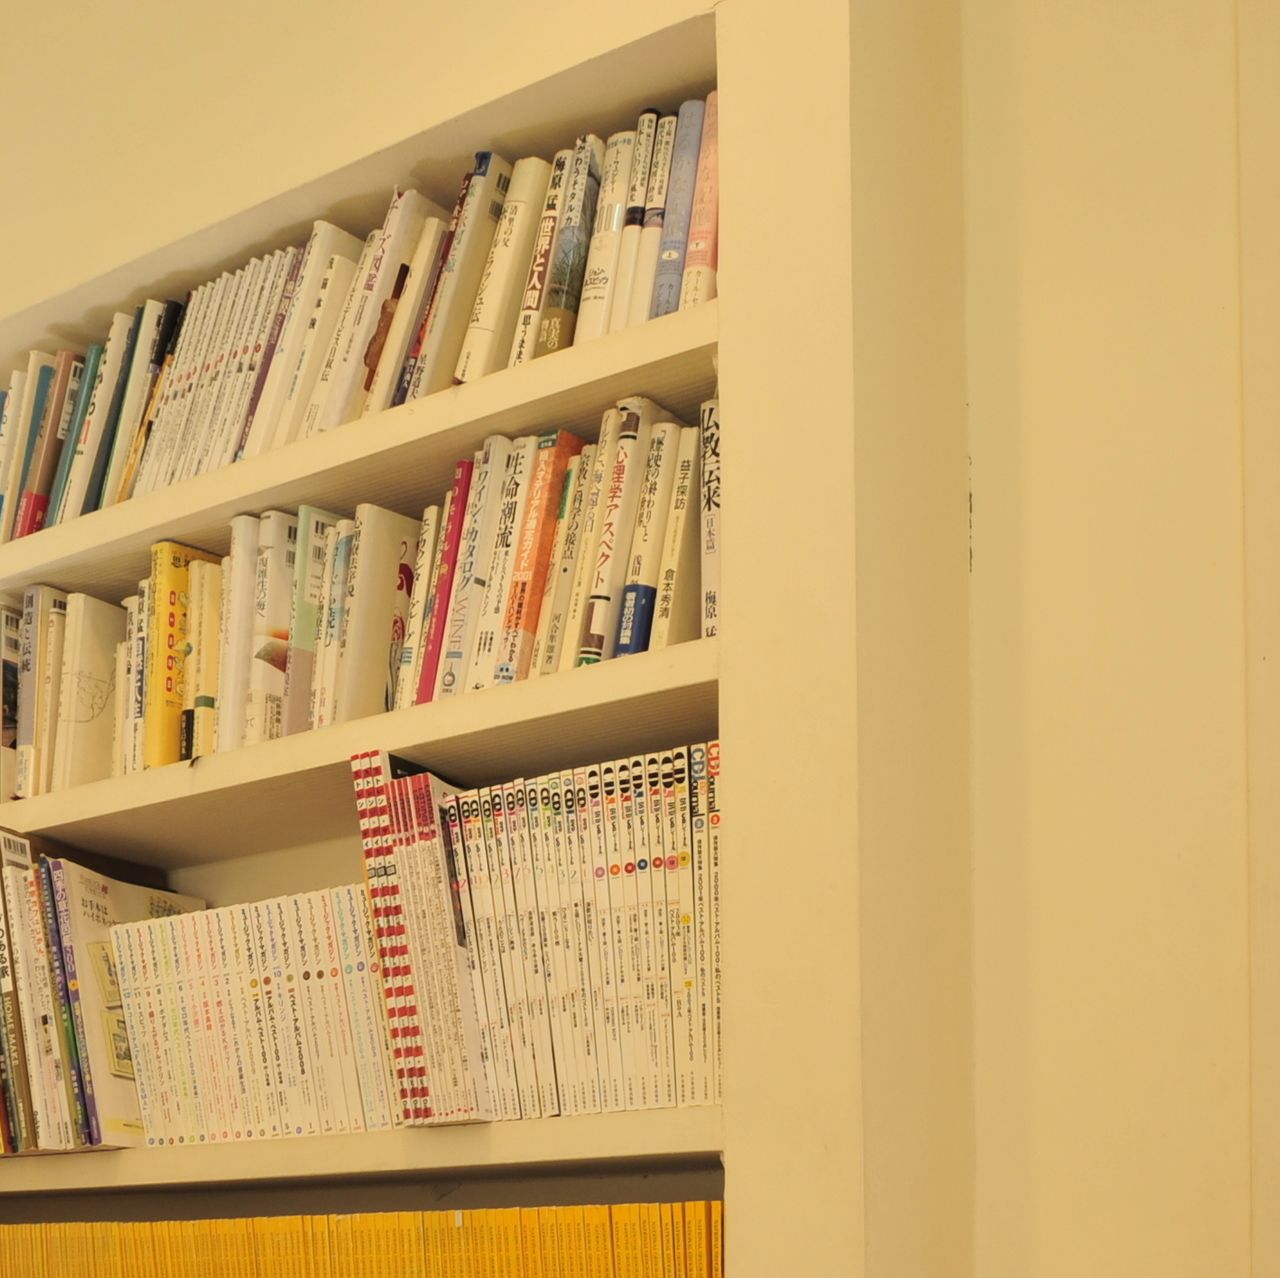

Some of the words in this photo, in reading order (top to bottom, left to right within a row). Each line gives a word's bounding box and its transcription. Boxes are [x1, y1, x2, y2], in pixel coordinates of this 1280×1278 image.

[522, 218, 556, 310] 世界と人間
[459, 470, 488, 593] ワイン・カタログ
[495, 452, 525, 549] 生命潮流
[595, 446, 628, 588] 心理学アスペクト
